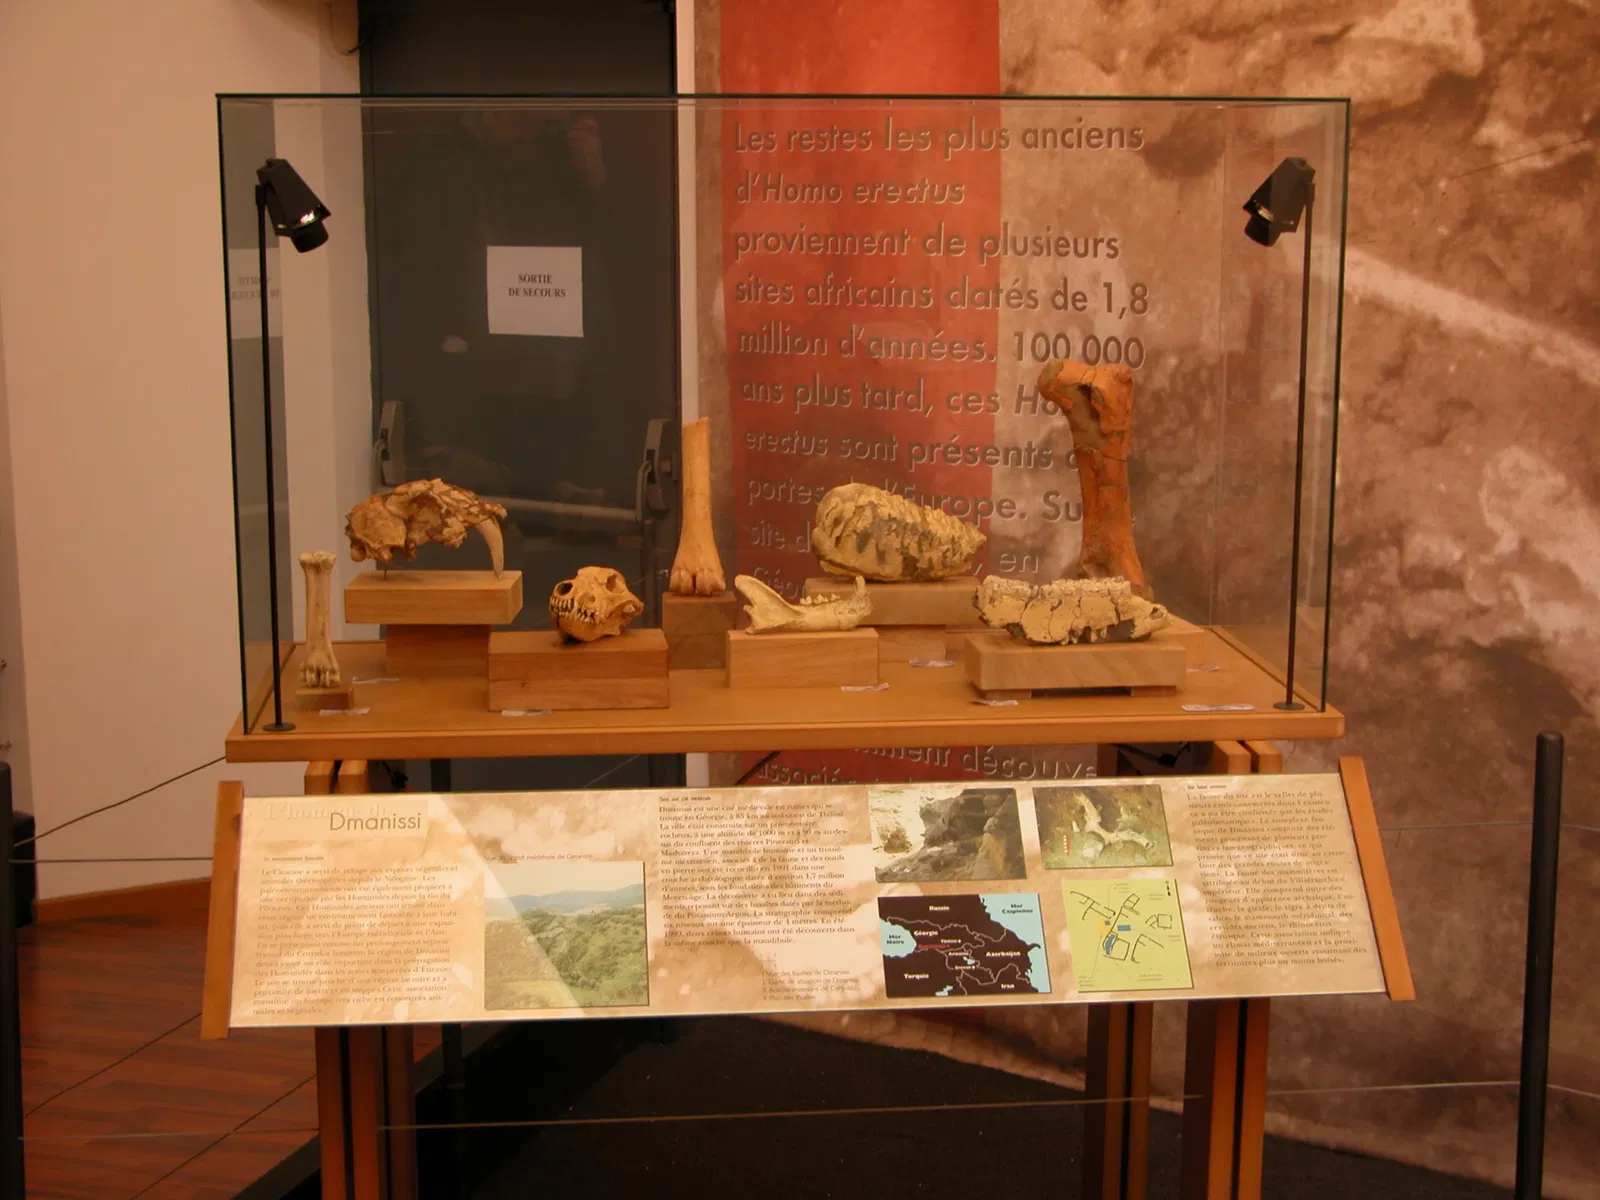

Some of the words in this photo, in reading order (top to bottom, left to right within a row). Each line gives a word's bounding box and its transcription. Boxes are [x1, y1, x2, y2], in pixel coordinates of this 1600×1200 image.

[735, 122, 776, 152] Les
[786, 126, 872, 152] restes
[883, 116, 931, 151] les
[944, 116, 1011, 160] plus
[1022, 116, 1145, 151] anciens
[735, 170, 842, 204] d'Homo
[852, 180, 966, 204] erectus
[735, 225, 911, 261] proviennent
[922, 223, 968, 257] de
[978, 223, 1120, 265] plusieurs
[508, 287, 521, 297] DE
[523, 287, 567, 299] SECOURS
[518, 273, 553, 284] SORTIE
[735, 279, 794, 305] sites
[806, 275, 934, 308] africains
[946, 275, 1040, 310] datés
[1050, 278, 1089, 312] de
[1102, 282, 1149, 319] 1,8
[738, 321, 828, 356] million
[838, 323, 997, 363] d'années.
[1014, 331, 1071, 363] 100
[1082, 334, 1146, 370] 000
[741, 379, 784, 403] ans
[794, 378, 852, 413] plus
[860, 378, 933, 417] tard,
[946, 387, 1001, 414] ces
[745, 430, 829, 457] erectus
[839, 434, 902, 462] sont
[908, 436, 1054, 472] présents
[1042, 490, 1083, 523] Su
[750, 519, 785, 550] site
[1000, 552, 1040, 573] en
[330, 812, 422, 831] Dmanissi
[913, 929, 938, 937] Géorgie
